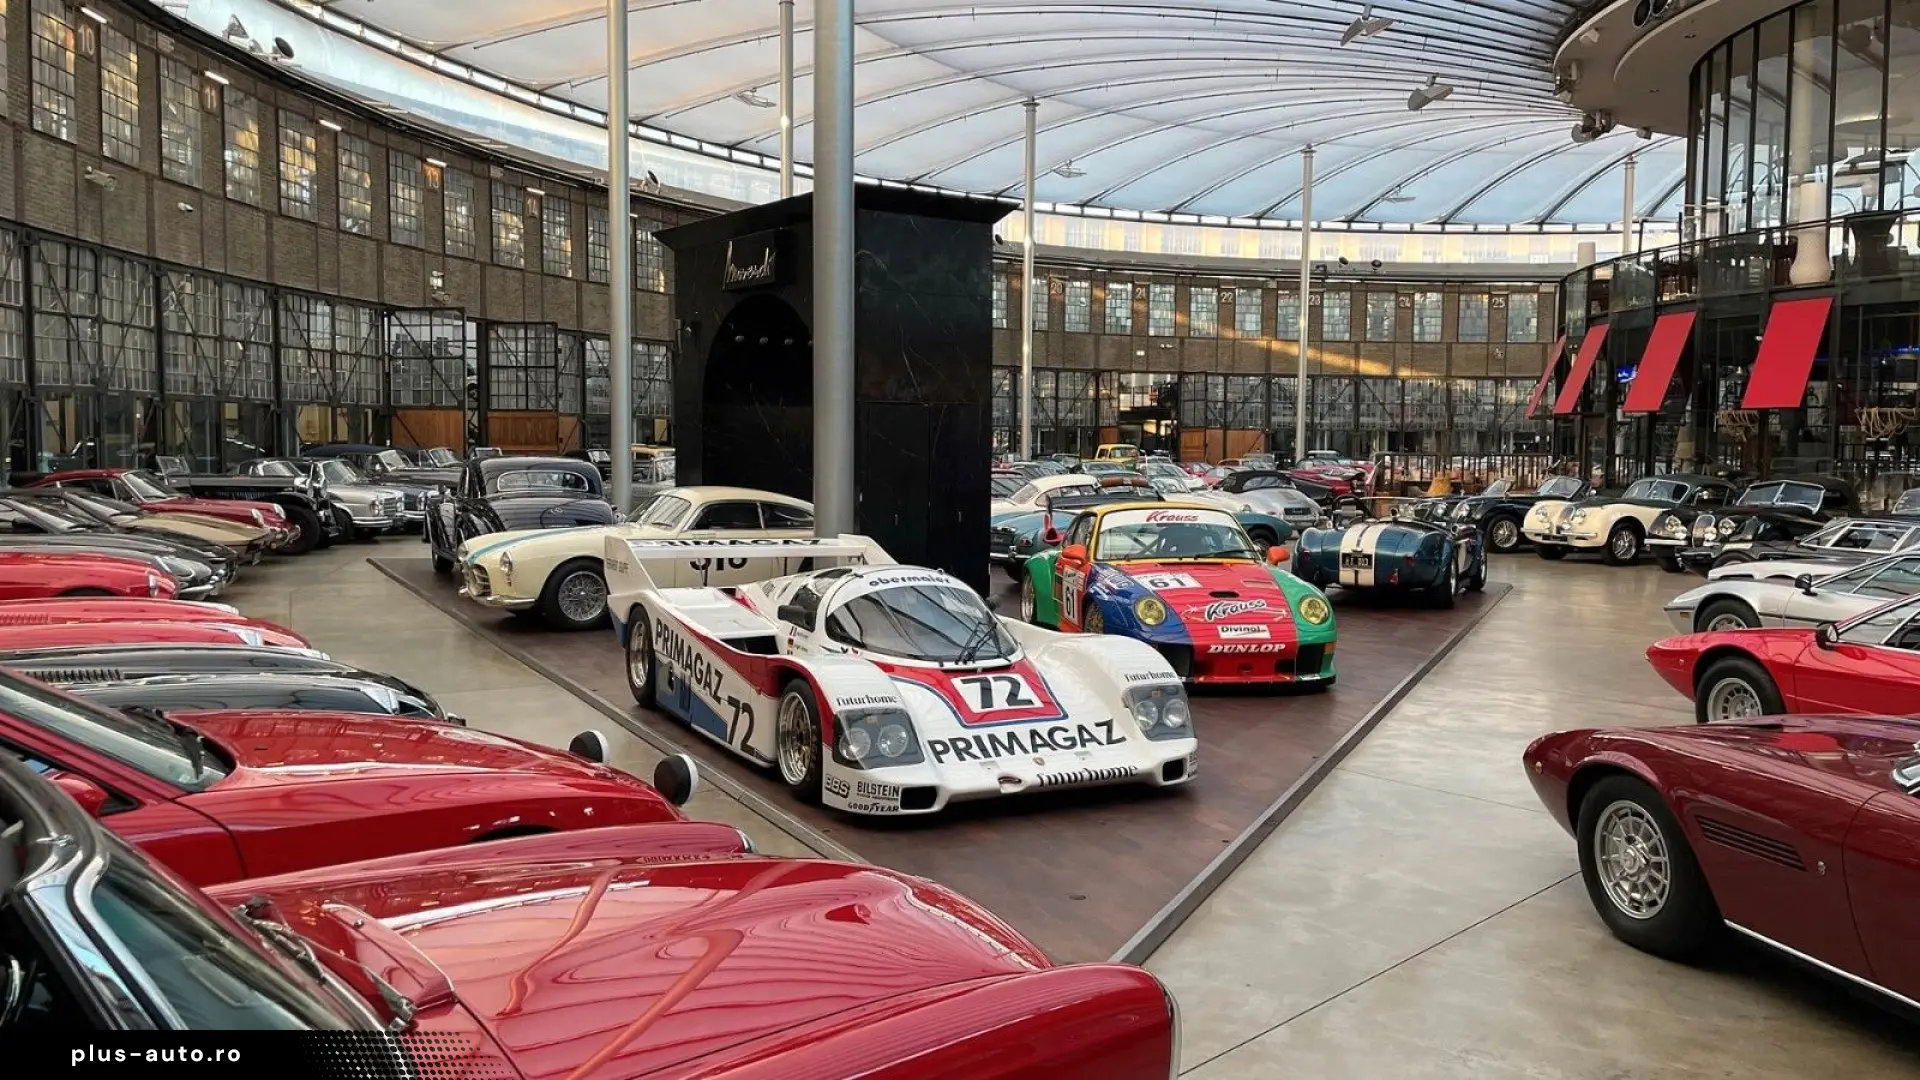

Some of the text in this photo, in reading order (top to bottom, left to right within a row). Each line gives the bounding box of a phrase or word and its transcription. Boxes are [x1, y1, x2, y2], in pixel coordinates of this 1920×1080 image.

[78, 23, 96, 56] 10
[1050, 282, 1063, 295] 20
[1136, 287, 1147, 299] 21
[1220, 291, 1233, 303] 22
[1309, 295, 1321, 306] 23
[1492, 296, 1506, 308] 25
[1146, 510, 1199, 523] Krauss
[869, 575, 951, 587] obermaier
[1149, 577, 1187, 588] 61
[1065, 585, 1075, 619] 61
[1206, 600, 1267, 622] Krauss
[1207, 643, 1286, 654] DUNLOP
[655, 617, 723, 705] PRIMAGAZ
[960, 675, 1035, 710] 72
[727, 695, 756, 757] 72
[926, 719, 1126, 764] PRIMAGAZ
[824, 773, 851, 799] BBS
[857, 780, 900, 797] BILSTEIN
